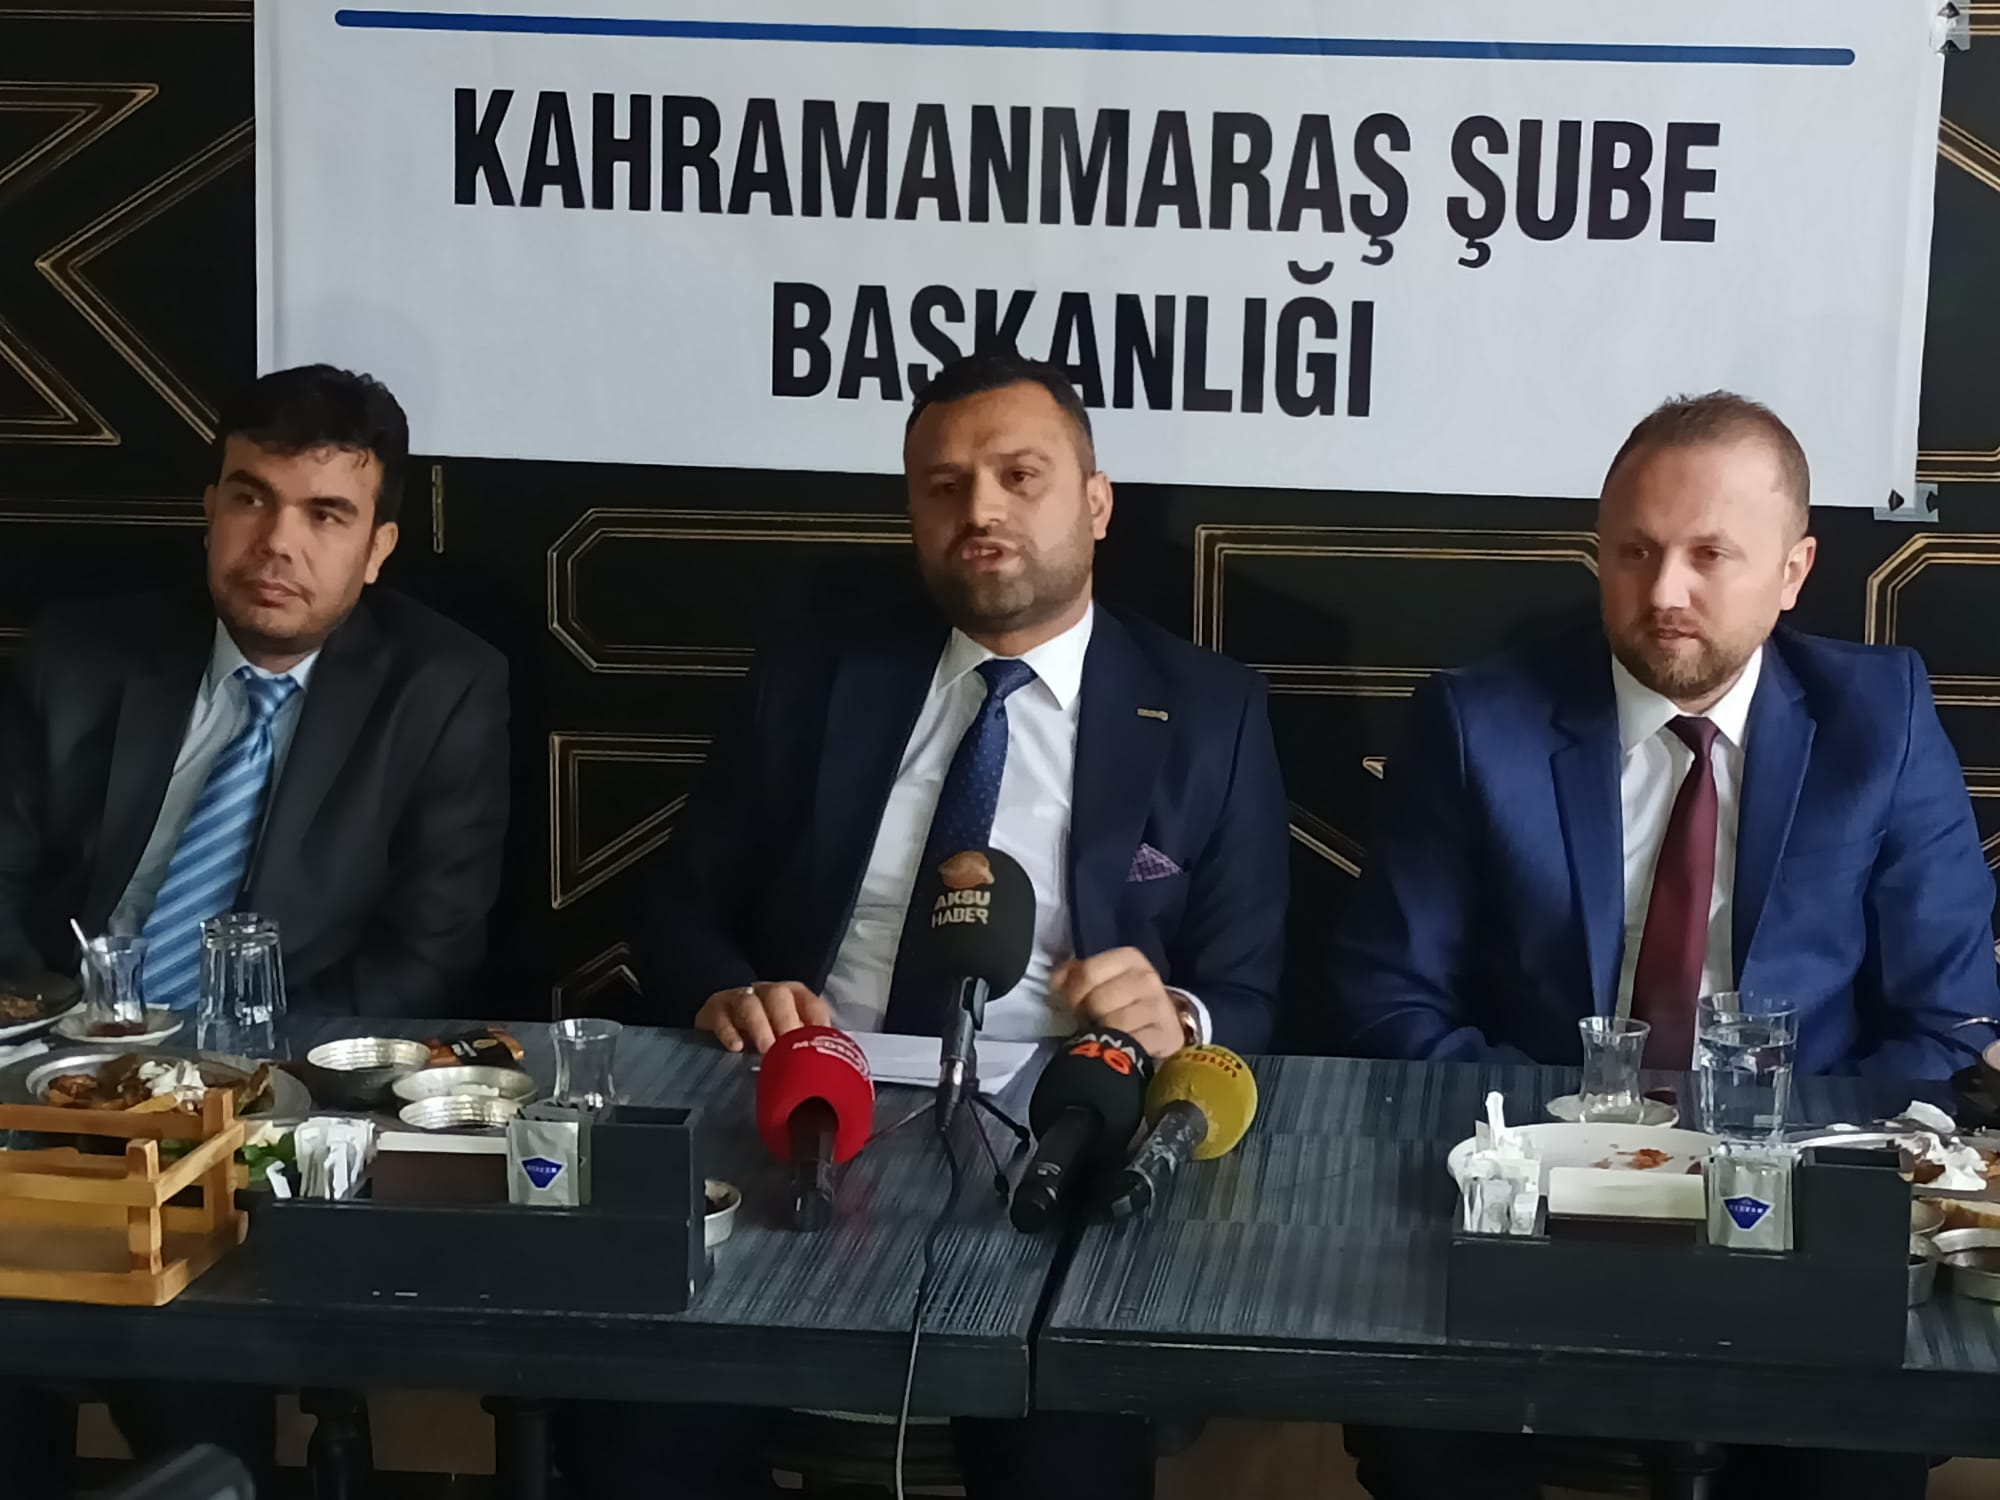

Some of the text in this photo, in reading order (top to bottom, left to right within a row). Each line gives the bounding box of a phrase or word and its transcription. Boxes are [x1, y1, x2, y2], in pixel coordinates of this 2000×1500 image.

[454, 87, 1721, 270] KAHRAMANMARAŞ ŞUBE
[934, 889, 991, 911] AKSU
[1064, 1032, 1146, 1079] ANAL
